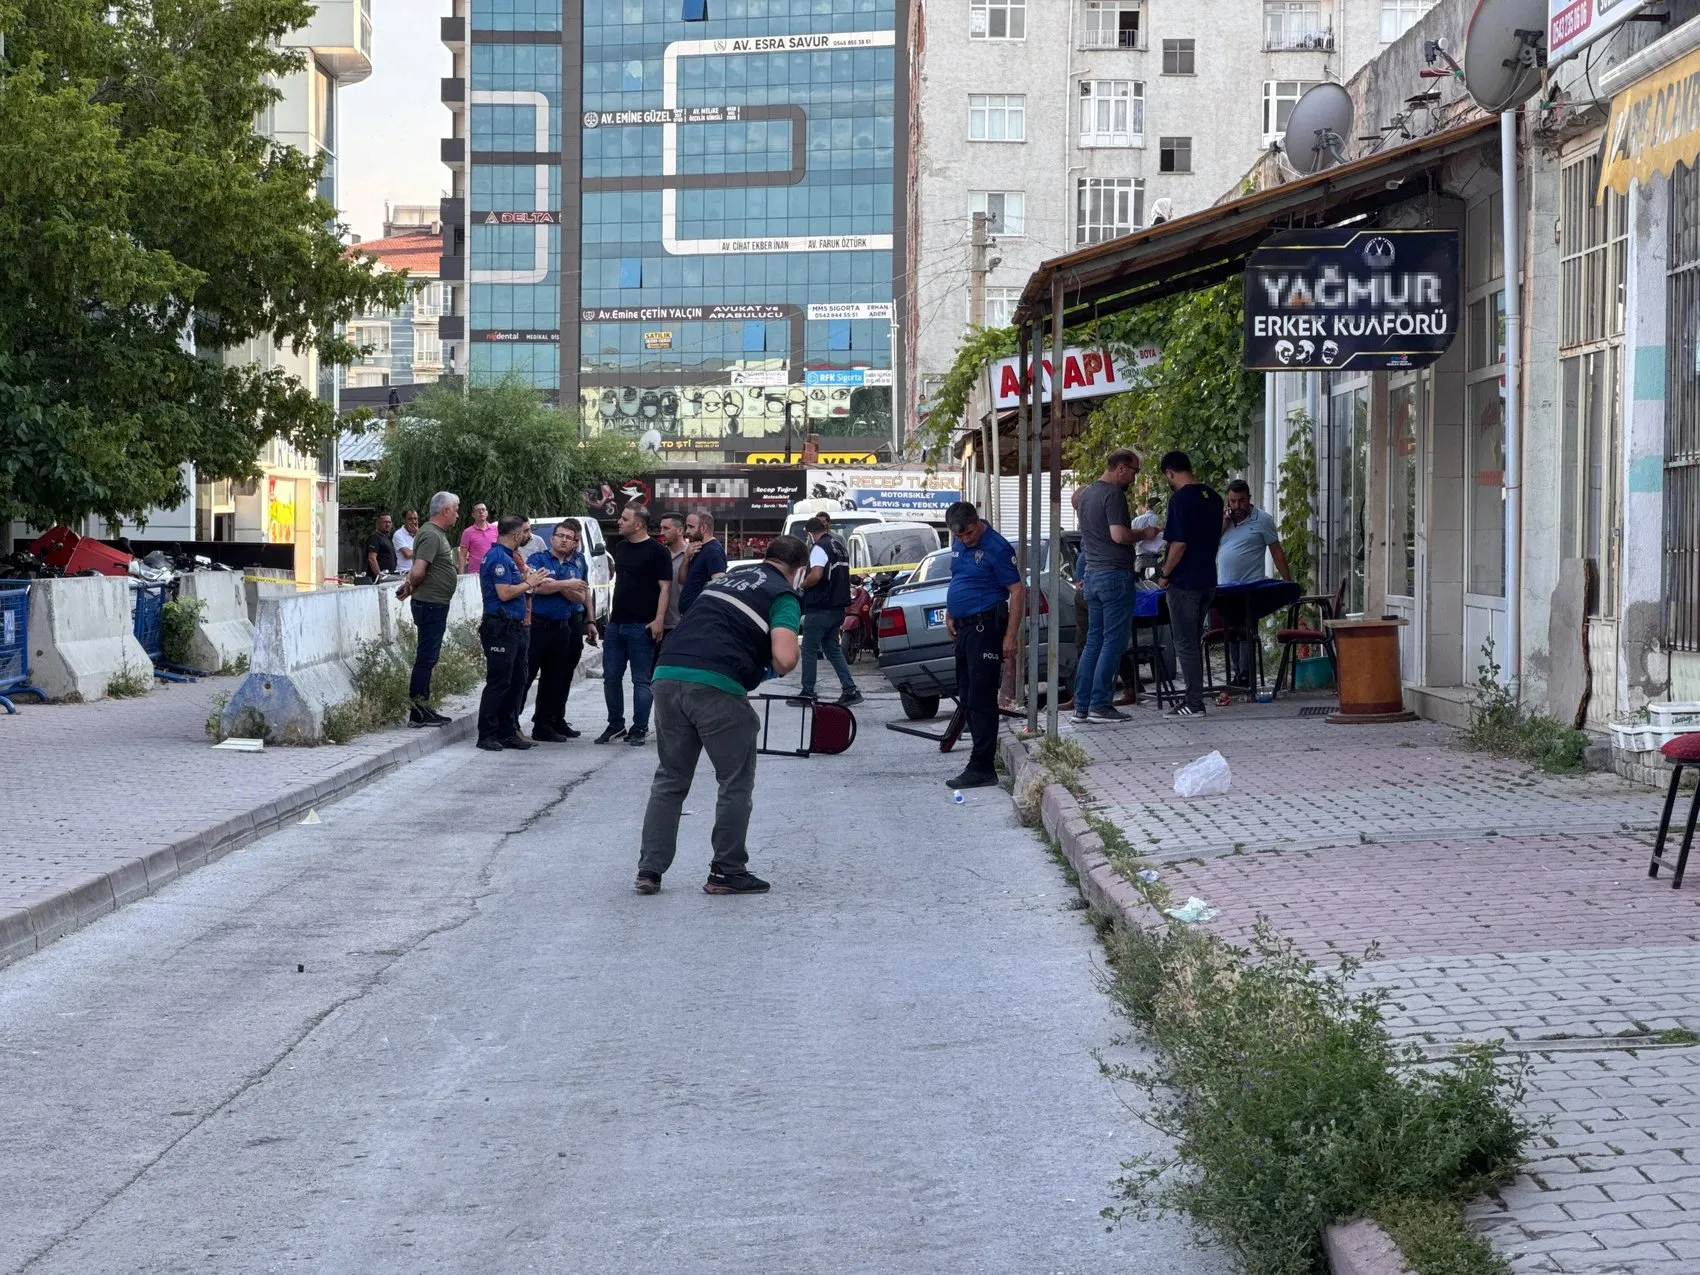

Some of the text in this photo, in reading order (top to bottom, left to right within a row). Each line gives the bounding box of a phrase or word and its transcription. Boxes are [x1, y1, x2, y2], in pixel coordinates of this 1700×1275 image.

[733, 40, 752, 51] AV.
[755, 38, 785, 49] ESRA
[789, 36, 829, 48] SAVUR
[601, 113, 615, 124] AV.
[616, 110, 641, 124] EMİNE
[643, 109, 671, 123] GÜZEL
[502, 212, 554, 223] DELTA
[721, 242, 731, 251] AV.
[732, 240, 751, 251] CİHAT
[752, 240, 773, 249] EKBER
[808, 238, 867, 249] AV. FARUK ÖZTÜRK
[640, 307, 667, 319] ÇETİN
[669, 307, 702, 319] YALÇIN
[1255, 315, 1327, 337] ERKEK
[820, 374, 835, 382] RFK
[837, 373, 862, 383] Sigorta
[1000, 352, 1115, 399] AAPI
[850, 476, 903, 489] RECEP
[912, 501, 939, 509] YEDEK
